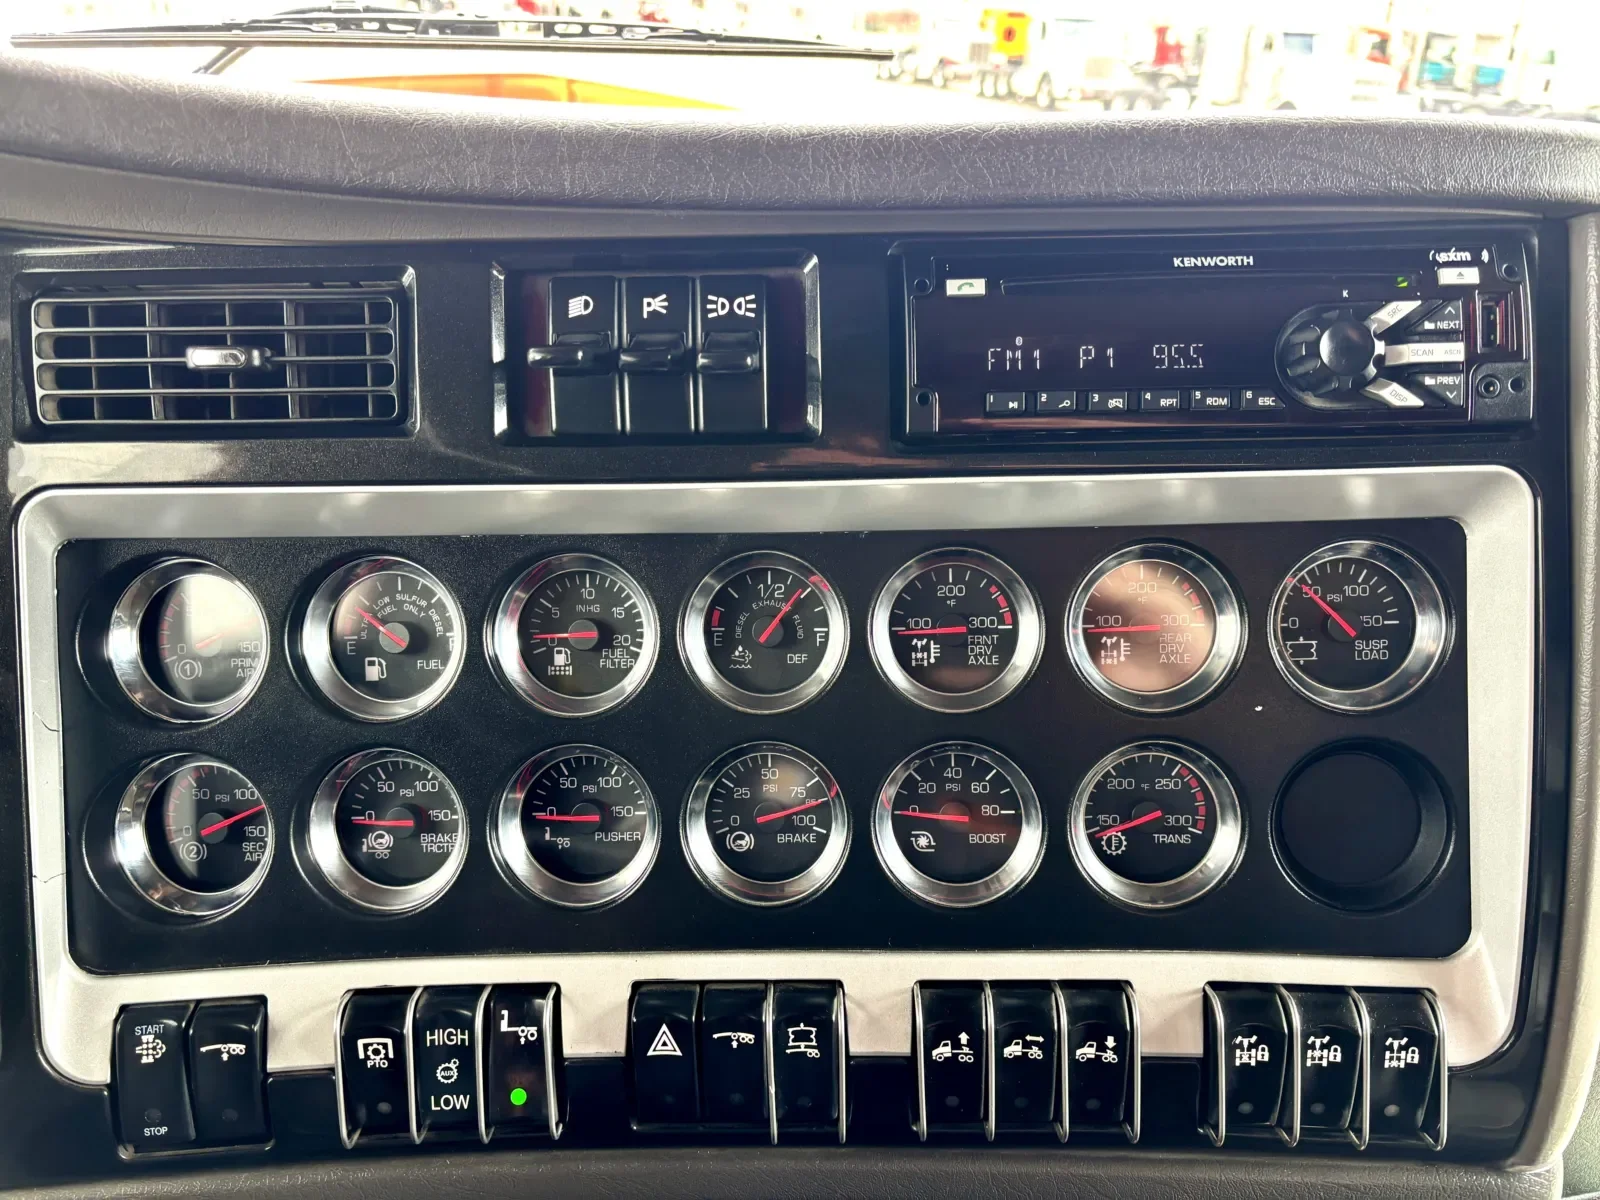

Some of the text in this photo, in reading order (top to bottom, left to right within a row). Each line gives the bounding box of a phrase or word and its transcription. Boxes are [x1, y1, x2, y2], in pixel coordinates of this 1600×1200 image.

[1173, 256, 1254, 267] KENWORTH
[1387, 304, 1403, 318] SRC
[1436, 321, 1460, 329] NEXT
[988, 344, 1204, 371] FM1 P1 95.5
[1410, 348, 1434, 356] SCAN
[1437, 376, 1460, 385] PREV
[1040, 394, 1047, 402] 2
[1092, 394, 1099, 402] 3
[1145, 392, 1177, 407] 4 RPT
[1246, 391, 1276, 406] 6 ESC
[1390, 389, 1408, 403] DISP
[1206, 398, 1228, 406] RDM
[757, 584, 784, 600] 1/2
[937, 584, 966, 597] 200
[1128, 582, 1157, 594] 200
[1302, 586, 1321, 598] 50
[1342, 584, 1370, 597] 100
[580, 588, 595, 600] 10
[1326, 594, 1343, 602] PSI
[372, 596, 390, 610] LOW
[396, 593, 428, 608] SULFUR
[428, 608, 444, 638] DIESEL
[377, 603, 426, 620] FUEL ONLY
[551, 607, 560, 618] 5
[611, 607, 624, 618] 15
[906, 618, 932, 629] 100
[968, 616, 998, 628] 300
[1096, 615, 1122, 627] 100
[1160, 614, 1190, 626] 300
[1288, 617, 1299, 629] 0
[735, 612, 750, 638] DIESEL
[792, 614, 804, 640] FLUID
[548, 636, 558, 646] 0
[612, 634, 631, 646] 20
[714, 632, 723, 646] E
[816, 632, 826, 647] F
[968, 635, 999, 644] FRNT
[1160, 633, 1192, 643] REAR
[178, 644, 186, 654] 0
[238, 641, 260, 653] 150
[346, 642, 356, 654] E
[968, 646, 992, 655] DRV
[1160, 644, 1184, 654] DRV
[1354, 640, 1388, 650] SUSP
[602, 648, 630, 658] FUEL
[1354, 650, 1388, 660] LOAD
[600, 659, 635, 668] FILTER
[787, 654, 808, 664] DEF
[968, 655, 999, 665] AXLE
[1160, 654, 1191, 664] AXLE
[417, 660, 445, 670] FUEL
[761, 768, 779, 780] 50
[943, 768, 962, 778] 40
[377, 782, 395, 792] 50
[414, 781, 438, 792] 100
[560, 777, 578, 788] 50
[596, 776, 622, 788] 100
[1107, 778, 1135, 790] 200
[1155, 778, 1181, 790] 250
[400, 788, 414, 797] PSI
[582, 785, 597, 793] PSI
[733, 788, 750, 798] 25
[762, 784, 778, 792] PSI
[789, 786, 806, 798] 75
[918, 782, 936, 794] 20
[946, 784, 961, 792] PSI
[971, 782, 990, 794] 60
[192, 788, 210, 800] 50
[215, 794, 230, 802] PSI
[233, 788, 258, 800] 100
[365, 810, 376, 820] 0
[428, 810, 451, 821] 150
[546, 806, 556, 816] 0
[610, 806, 634, 817] 150
[981, 804, 1000, 816] 80
[730, 815, 740, 826] 0
[792, 815, 816, 826] 100
[1096, 814, 1120, 826] 150
[1164, 815, 1192, 826] 300
[182, 826, 192, 836] 0
[243, 826, 266, 836] 150
[420, 833, 458, 843] BRAKE
[594, 832, 641, 842] PUSHER
[777, 833, 817, 843] BRAKE
[969, 834, 1006, 844] BOOST
[1153, 834, 1191, 844] TRANS
[242, 842, 264, 852] SEC
[244, 852, 263, 862] AIR
[134, 1024, 165, 1036] START
[426, 1028, 469, 1047] HIGH
[367, 1060, 388, 1068] PTO
[430, 1094, 470, 1110] LOW
[144, 1126, 168, 1136] STOP
